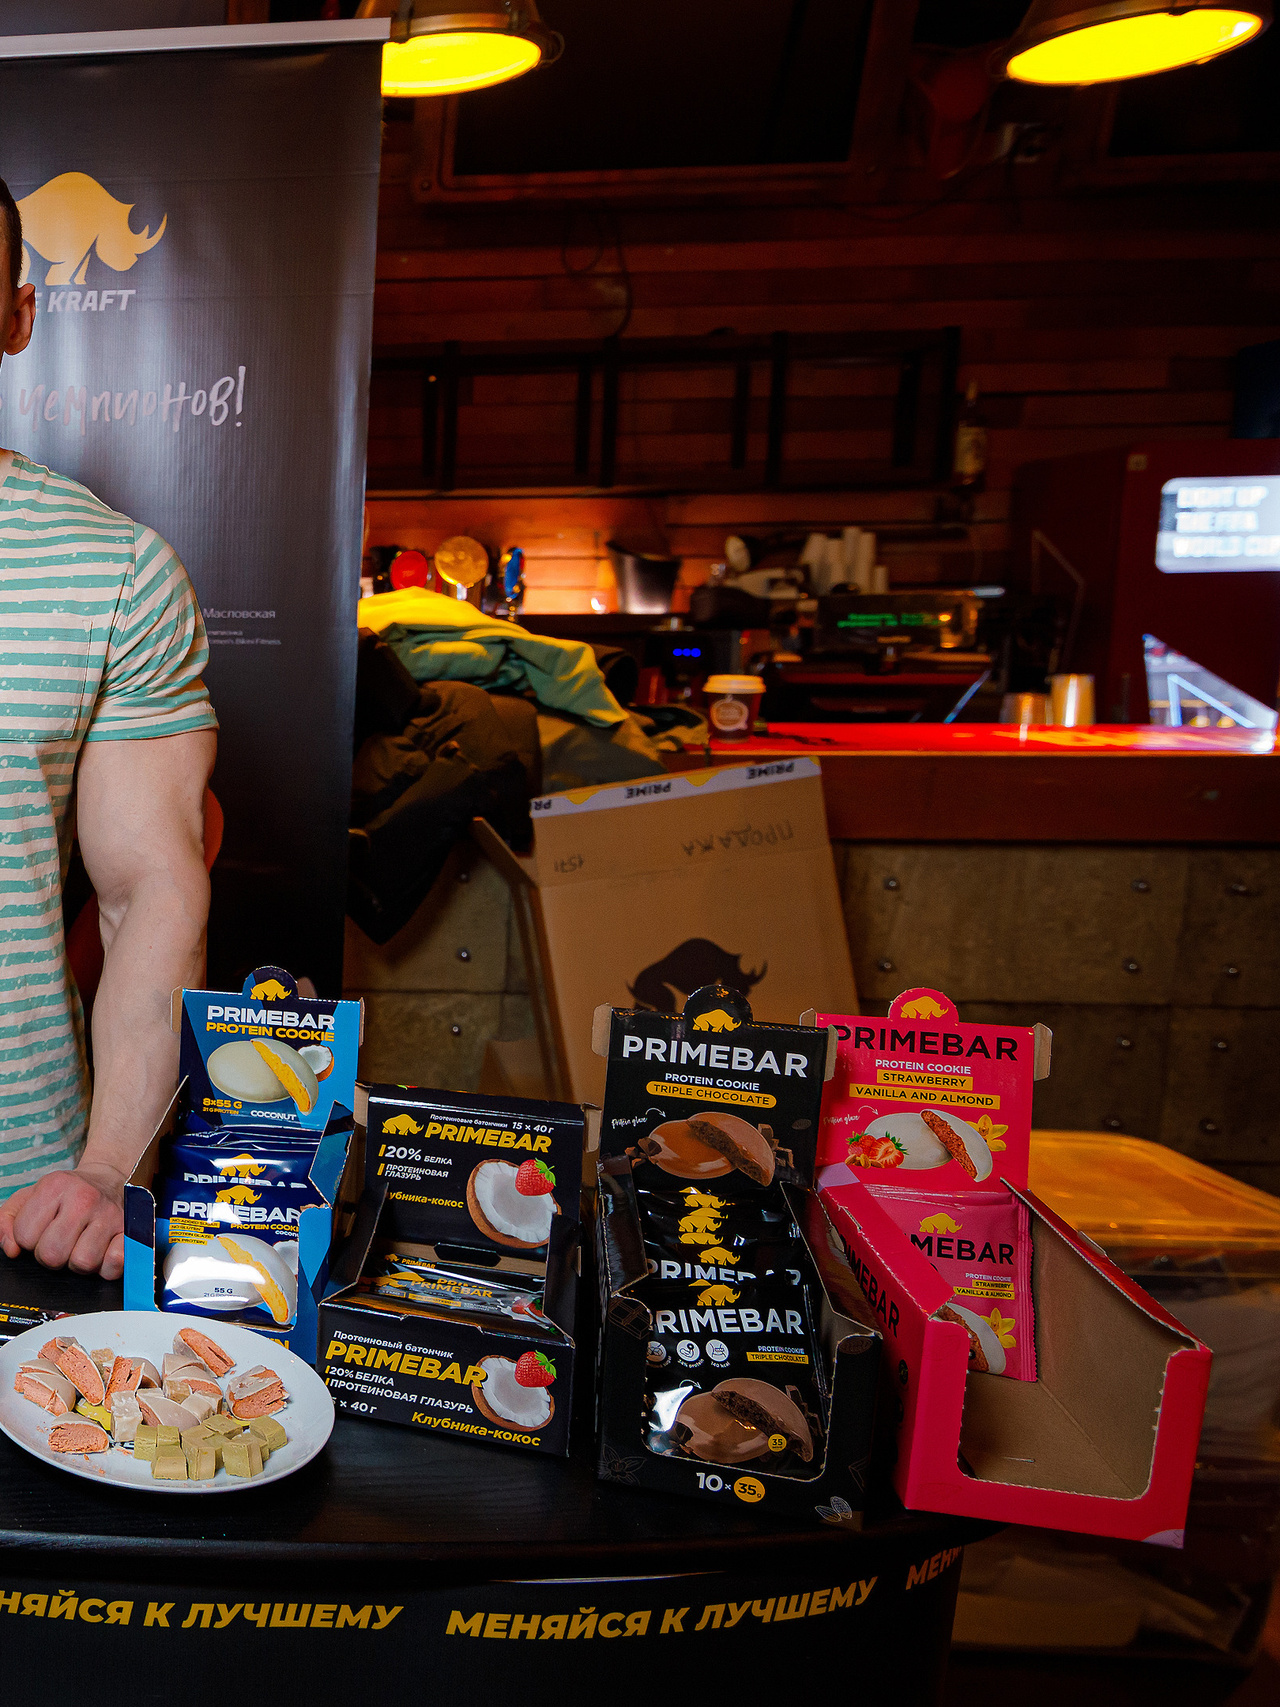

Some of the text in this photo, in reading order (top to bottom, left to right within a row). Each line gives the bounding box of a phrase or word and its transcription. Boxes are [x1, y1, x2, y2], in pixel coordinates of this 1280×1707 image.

[47, 289, 136, 312] KRAFT
[203, 608, 276, 619] Масловская
[746, 763, 795, 779] PRIME
[625, 781, 672, 799] PRIME
[681, 820, 795, 857] ПРОДАЖА
[207, 1005, 335, 1031] PRIMEBAR
[206, 1021, 335, 1043] PROTEIN COOKIE
[832, 1024, 1018, 1062] PRIMEBAR
[622, 1035, 809, 1079] PRIMEBAR
[875, 1059, 971, 1075] PROTEIN COOKIE
[665, 1073, 760, 1092] PROTEIN COOKIE
[883, 1073, 967, 1088] STRAWBERRY
[232, 1100, 242, 1109] G
[654, 1083, 770, 1106] TRIPLE CHOCOLATE
[856, 1086, 994, 1107] VANILLA AND ALMOND
[251, 1110, 296, 1121] COCONUT
[430, 1114, 473, 1125] Протеиновые
[474, 1118, 508, 1128] батончики
[512, 1122, 523, 1130] 15
[533, 1124, 546, 1133] 40
[424, 1122, 553, 1153] PRIMEBAR
[384, 1145, 453, 1166] 20% БЕЛКА
[385, 1170, 422, 1181] ГЛАЗУРЬ
[386, 1163, 449, 1178] ПРОТЕИНОВАЯ
[231, 1223, 270, 1231] PROTEIN
[411, 1281, 493, 1298] PRIMEBAR
[333, 1330, 454, 1359] Протеиновый батончик
[324, 1340, 488, 1388] PRIMEBAR
[329, 1366, 395, 1387] 20% БЕЛКА
[329, 1379, 474, 1414] ПРОТЕИНОВАЯ ГЛАЗУРЬ
[351, 1401, 369, 1413] 40
[411, 1411, 541, 1447] Клубника-кокос
[696, 1472, 723, 1492] 10
[143, 1602, 176, 1628] К
[181, 1603, 404, 1630] ЛУЧШЕМУ
[445, 1576, 878, 1640] МЕНЯЙСЯ К ЛУЧШЕМУ
